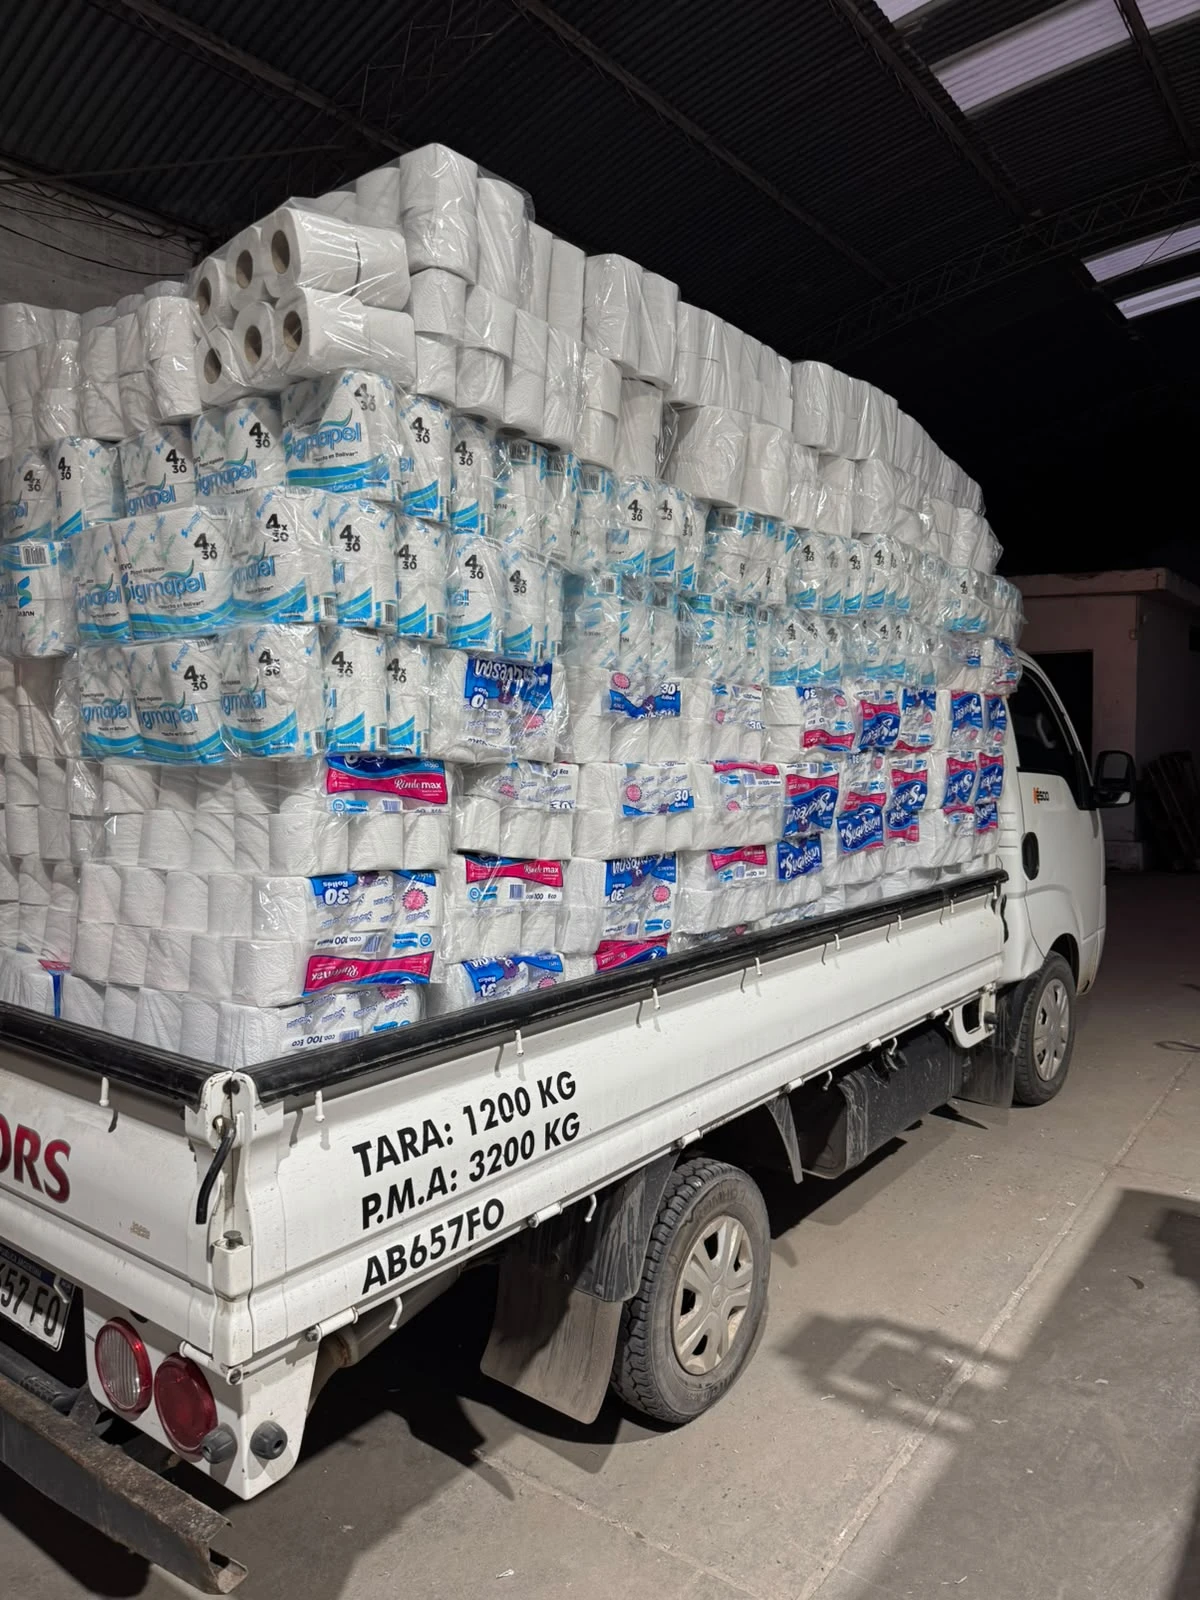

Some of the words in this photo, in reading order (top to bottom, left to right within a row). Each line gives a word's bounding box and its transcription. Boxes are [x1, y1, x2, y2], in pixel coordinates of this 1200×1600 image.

[674, 789, 689, 801] 30
[324, 888, 350, 906] 30
[306, 1036, 323, 1045] 100
[352, 1119, 453, 1178] TARA:
[463, 1086, 531, 1136] 1200
[537, 1071, 576, 1109] KG
[362, 1165, 458, 1230] P.M.A:
[469, 1130, 535, 1182] 3200
[544, 1112, 580, 1151] KG
[361, 1198, 505, 1295] AB657FO
[0, 1262, 29, 1316] 57
